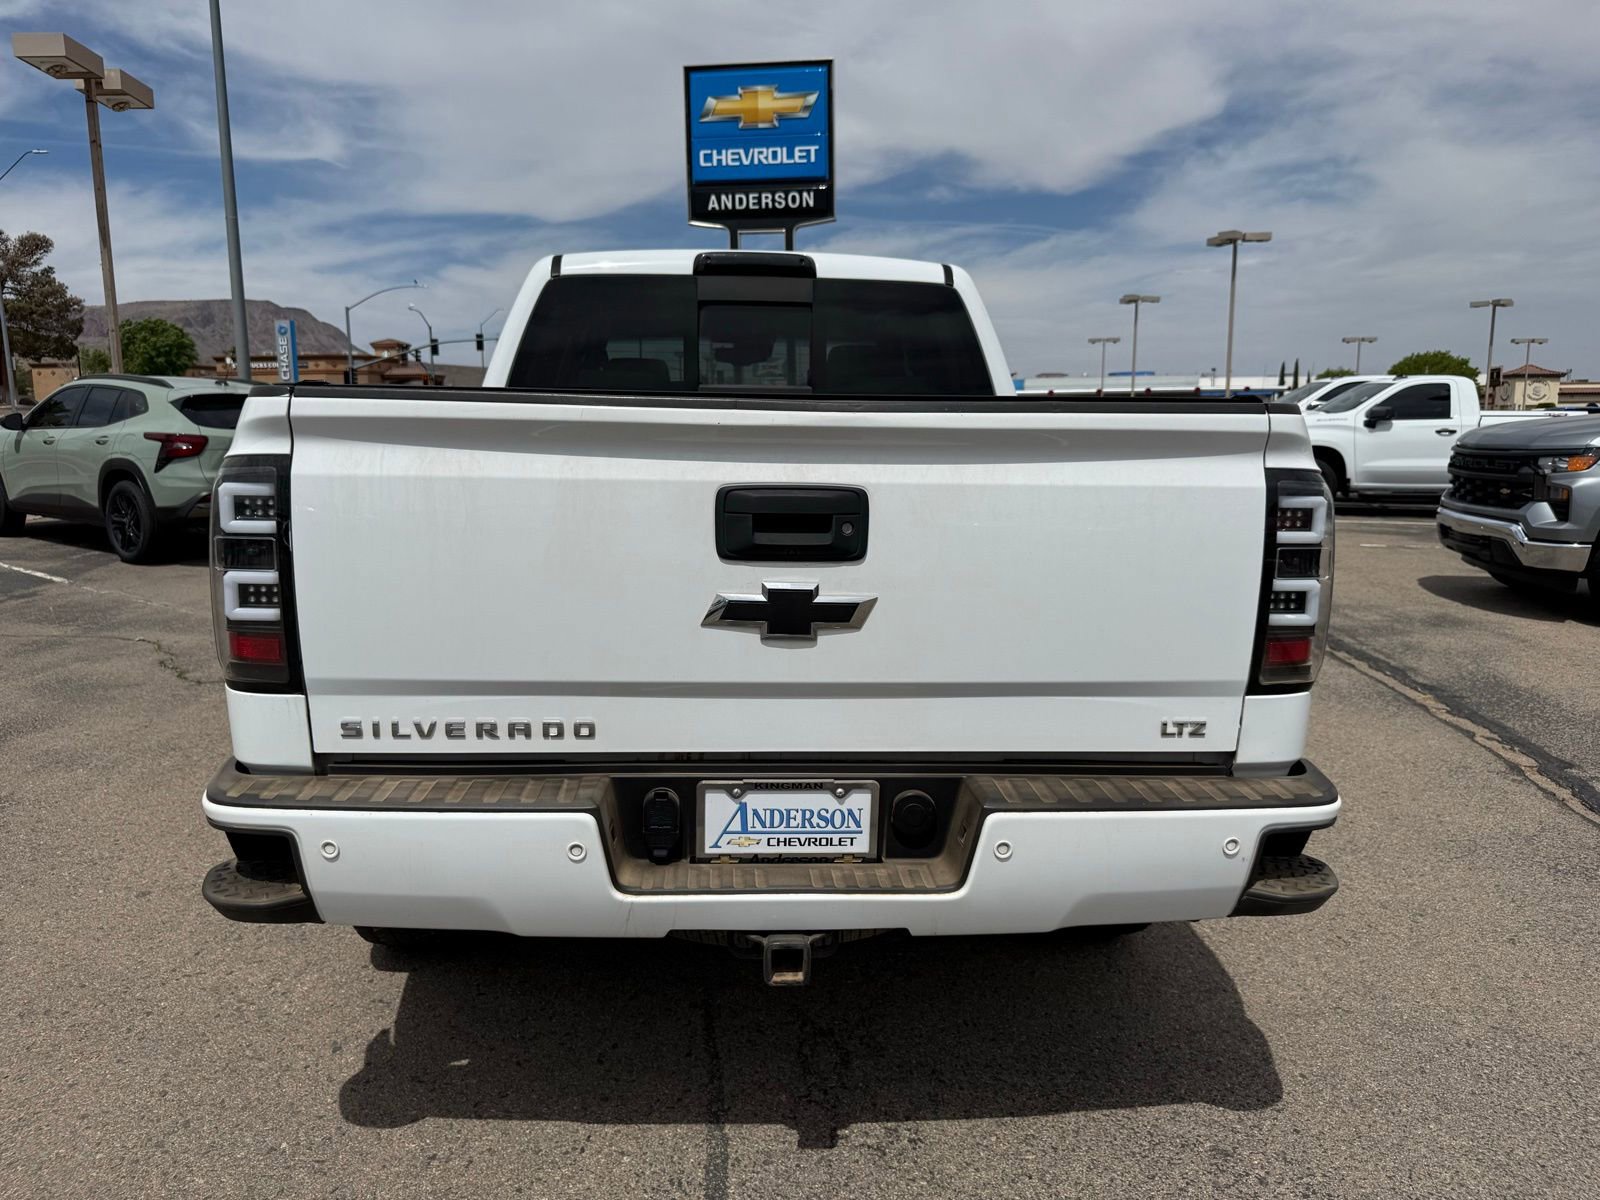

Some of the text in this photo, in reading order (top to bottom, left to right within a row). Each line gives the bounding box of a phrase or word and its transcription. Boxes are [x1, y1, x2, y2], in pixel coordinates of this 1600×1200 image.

[699, 145, 820, 167] CHEVROLET
[707, 191, 815, 211] ANDERSON
[279, 336, 290, 380] CHASE
[340, 718, 597, 740] SILVERADO
[1160, 719, 1207, 739] LTZ
[754, 782, 824, 790] KINGMAN
[708, 801, 864, 849] ANDERSON
[766, 836, 857, 847] CHEVROLET
